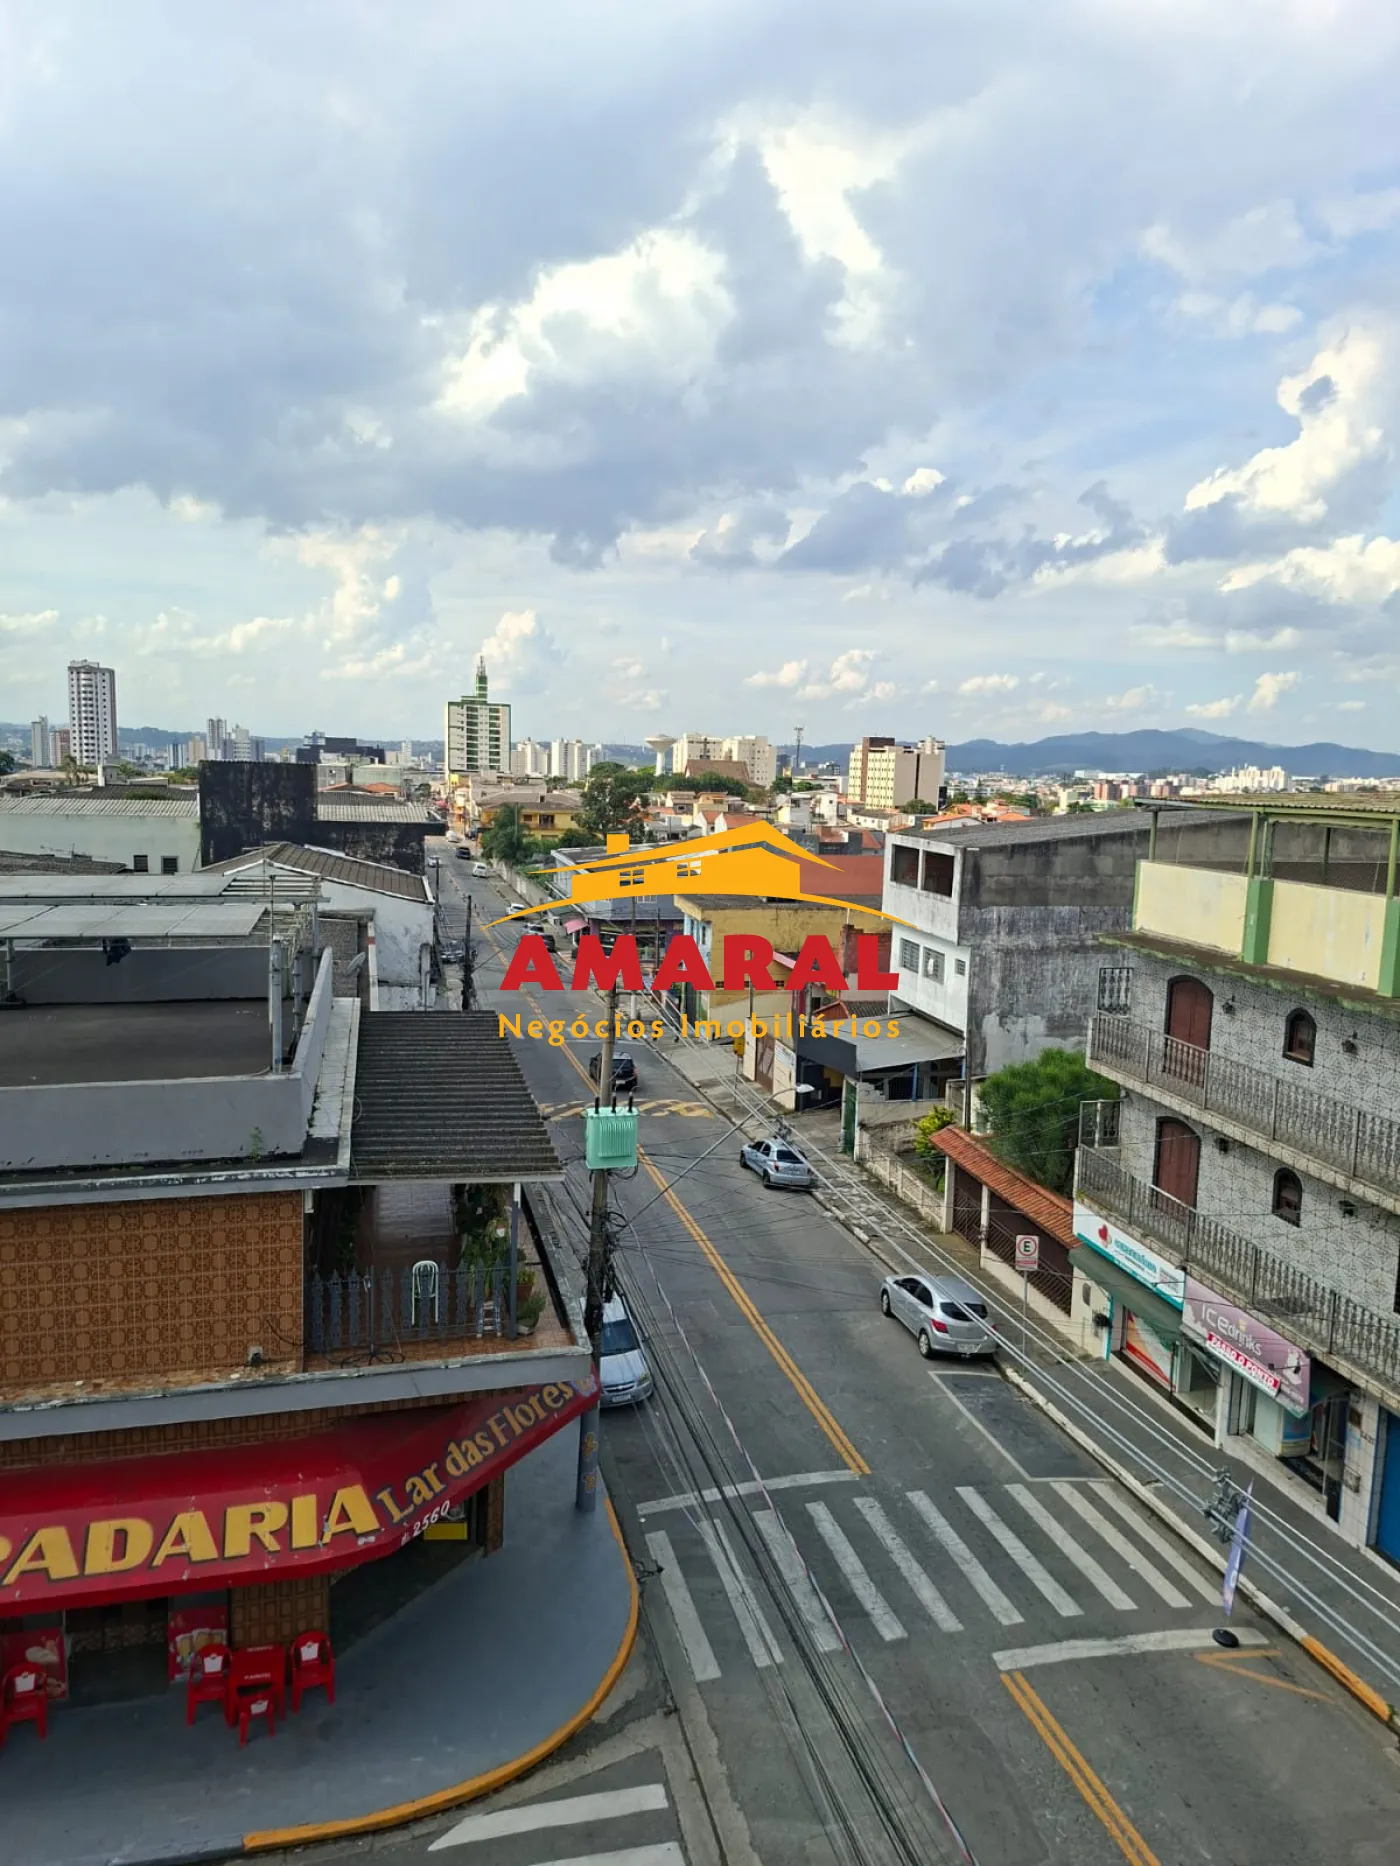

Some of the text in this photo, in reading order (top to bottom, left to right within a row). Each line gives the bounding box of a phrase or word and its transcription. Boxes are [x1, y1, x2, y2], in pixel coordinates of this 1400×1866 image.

[1023, 1240, 1031, 1253] E
[376, 1381, 575, 1523] Lar das Flores
[412, 1499, 450, 1537] 2560
